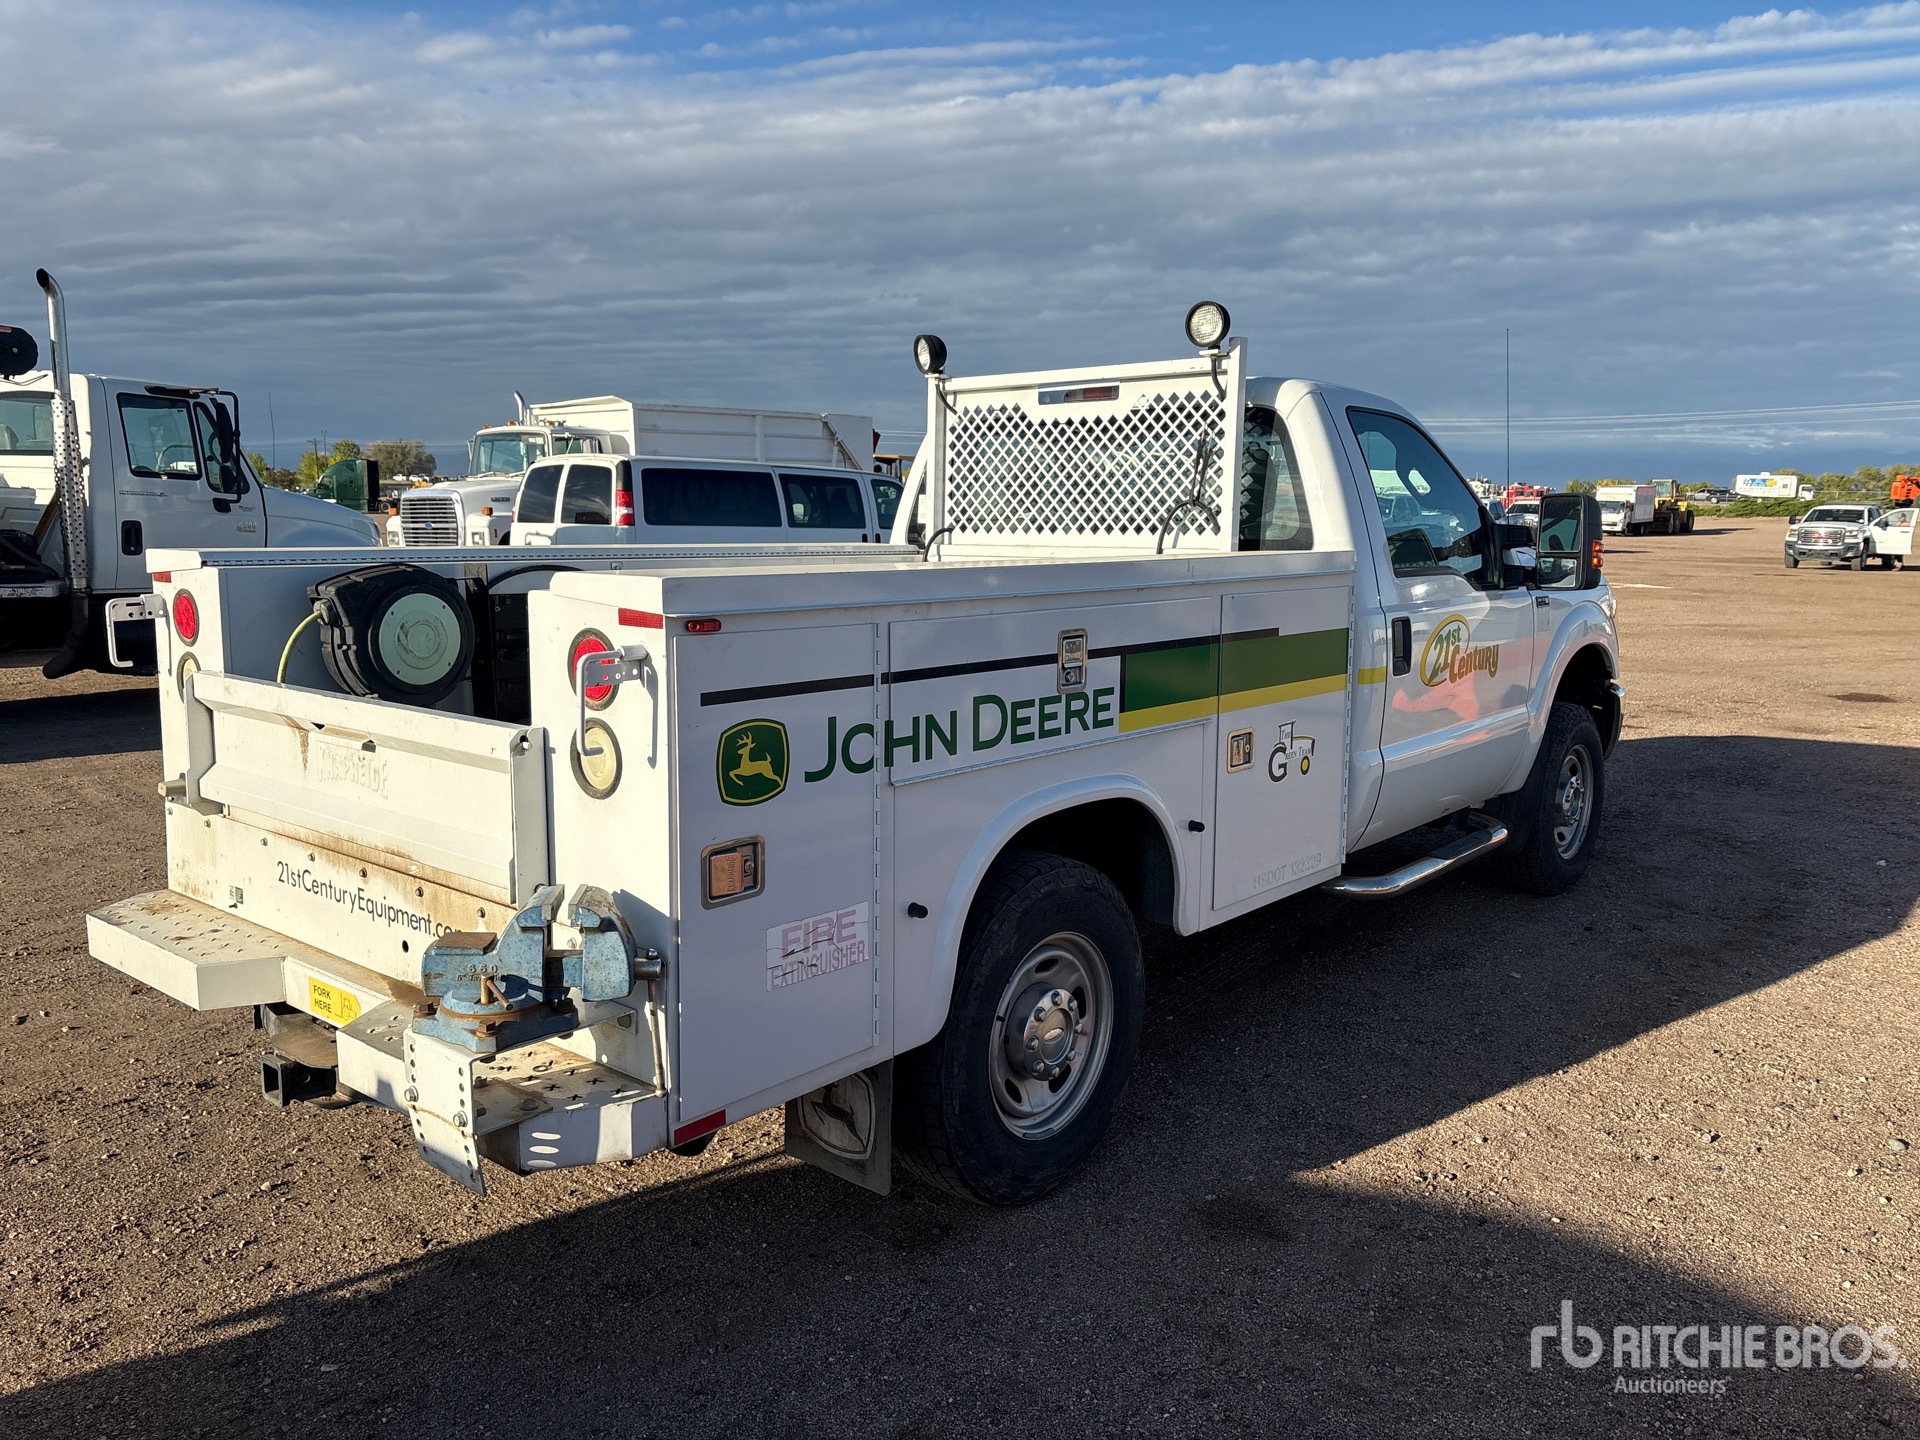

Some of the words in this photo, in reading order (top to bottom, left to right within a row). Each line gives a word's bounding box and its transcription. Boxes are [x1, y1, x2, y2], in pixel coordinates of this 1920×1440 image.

[1429, 624, 1461, 682] 21st
[804, 710, 957, 783] JOHN
[973, 686, 1115, 752] DEERE
[276, 860, 463, 938] 21stCenturyEquipment.co
[781, 909, 857, 960] FIRE
[771, 939, 866, 991] EXTINGUISHER
[313, 985, 332, 1001] FORK
[314, 998, 332, 1014] HERE
